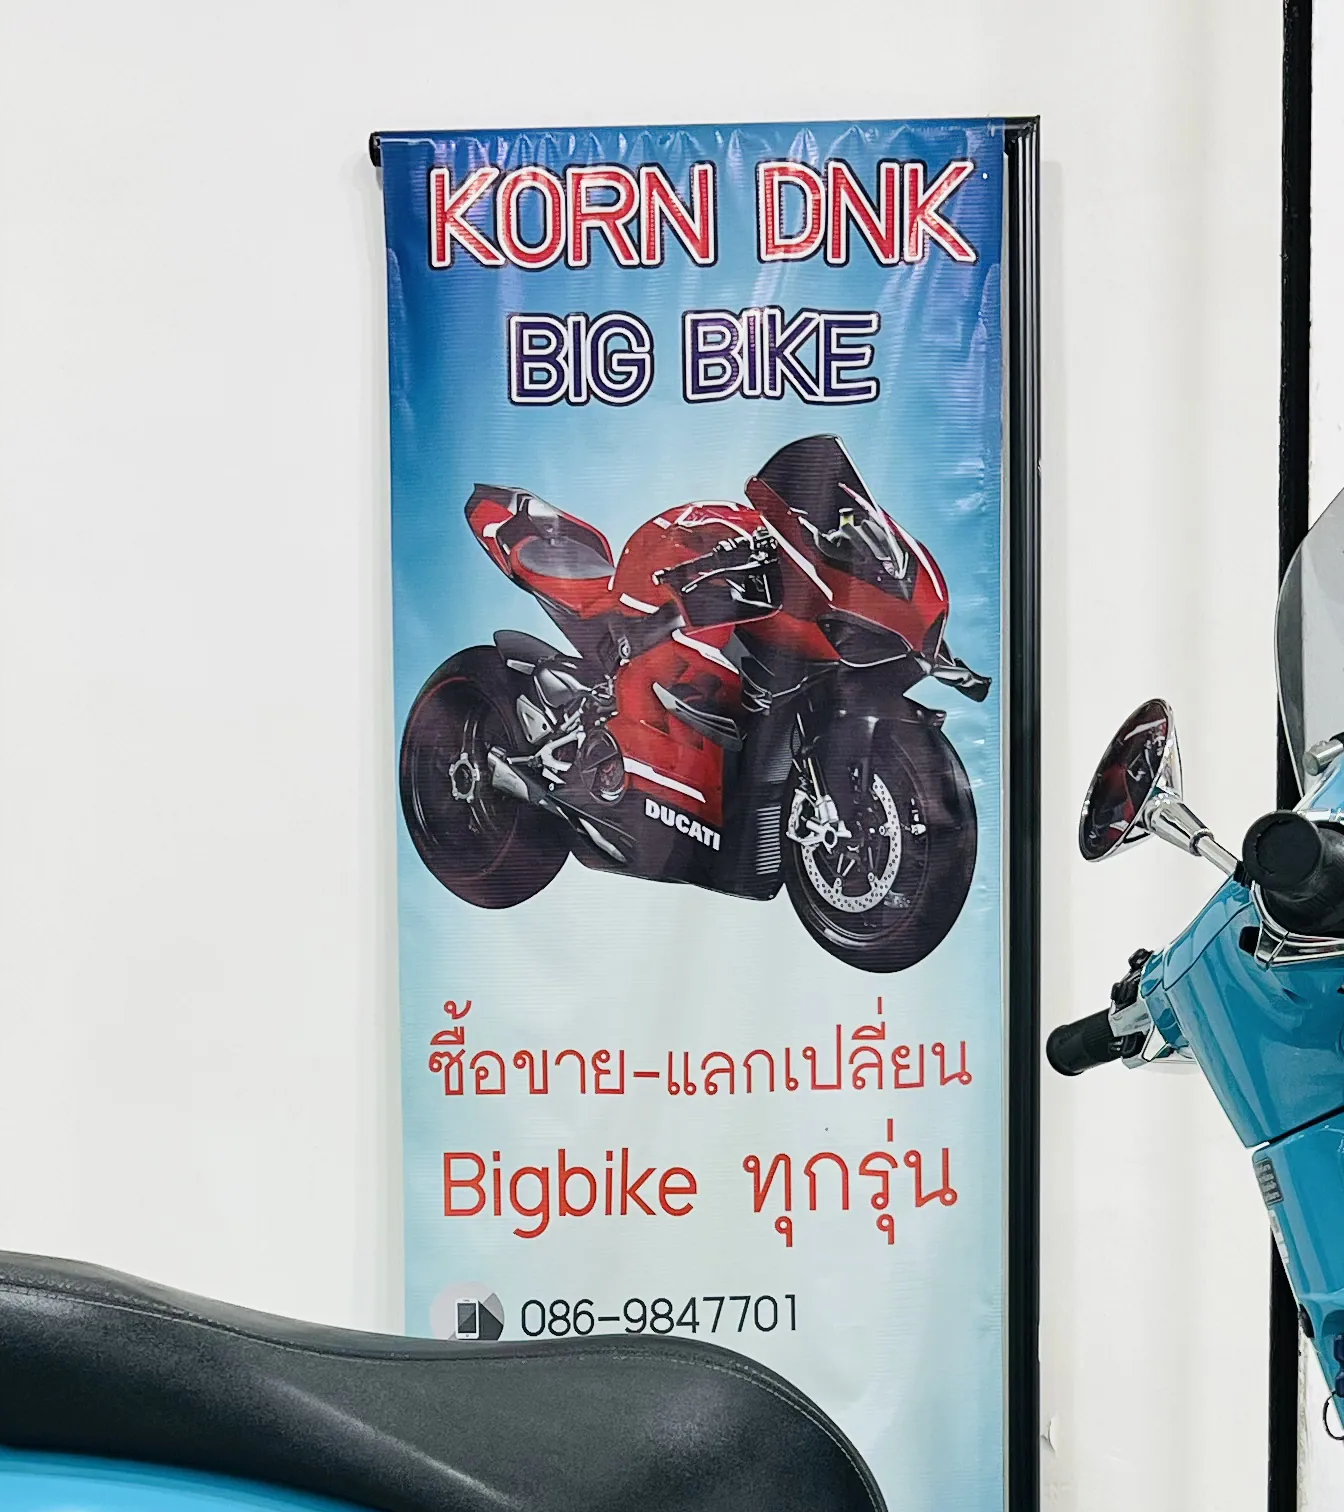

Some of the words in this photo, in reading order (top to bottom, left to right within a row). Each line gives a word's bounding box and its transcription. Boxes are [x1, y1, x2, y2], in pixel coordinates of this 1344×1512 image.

[430, 160, 717, 268] KORN
[758, 158, 978, 265] DNK
[508, 311, 654, 405] BIG
[683, 306, 881, 405] BIKE
[644, 798, 721, 851] DUCATI
[428, 997, 973, 1097] ซื้อขาย-แลกเปลี่ยน
[442, 1147, 698, 1239] Bigbike
[742, 1118, 958, 1248] ทุกรุ่น
[520, 1293, 799, 1338] 086-9847701
